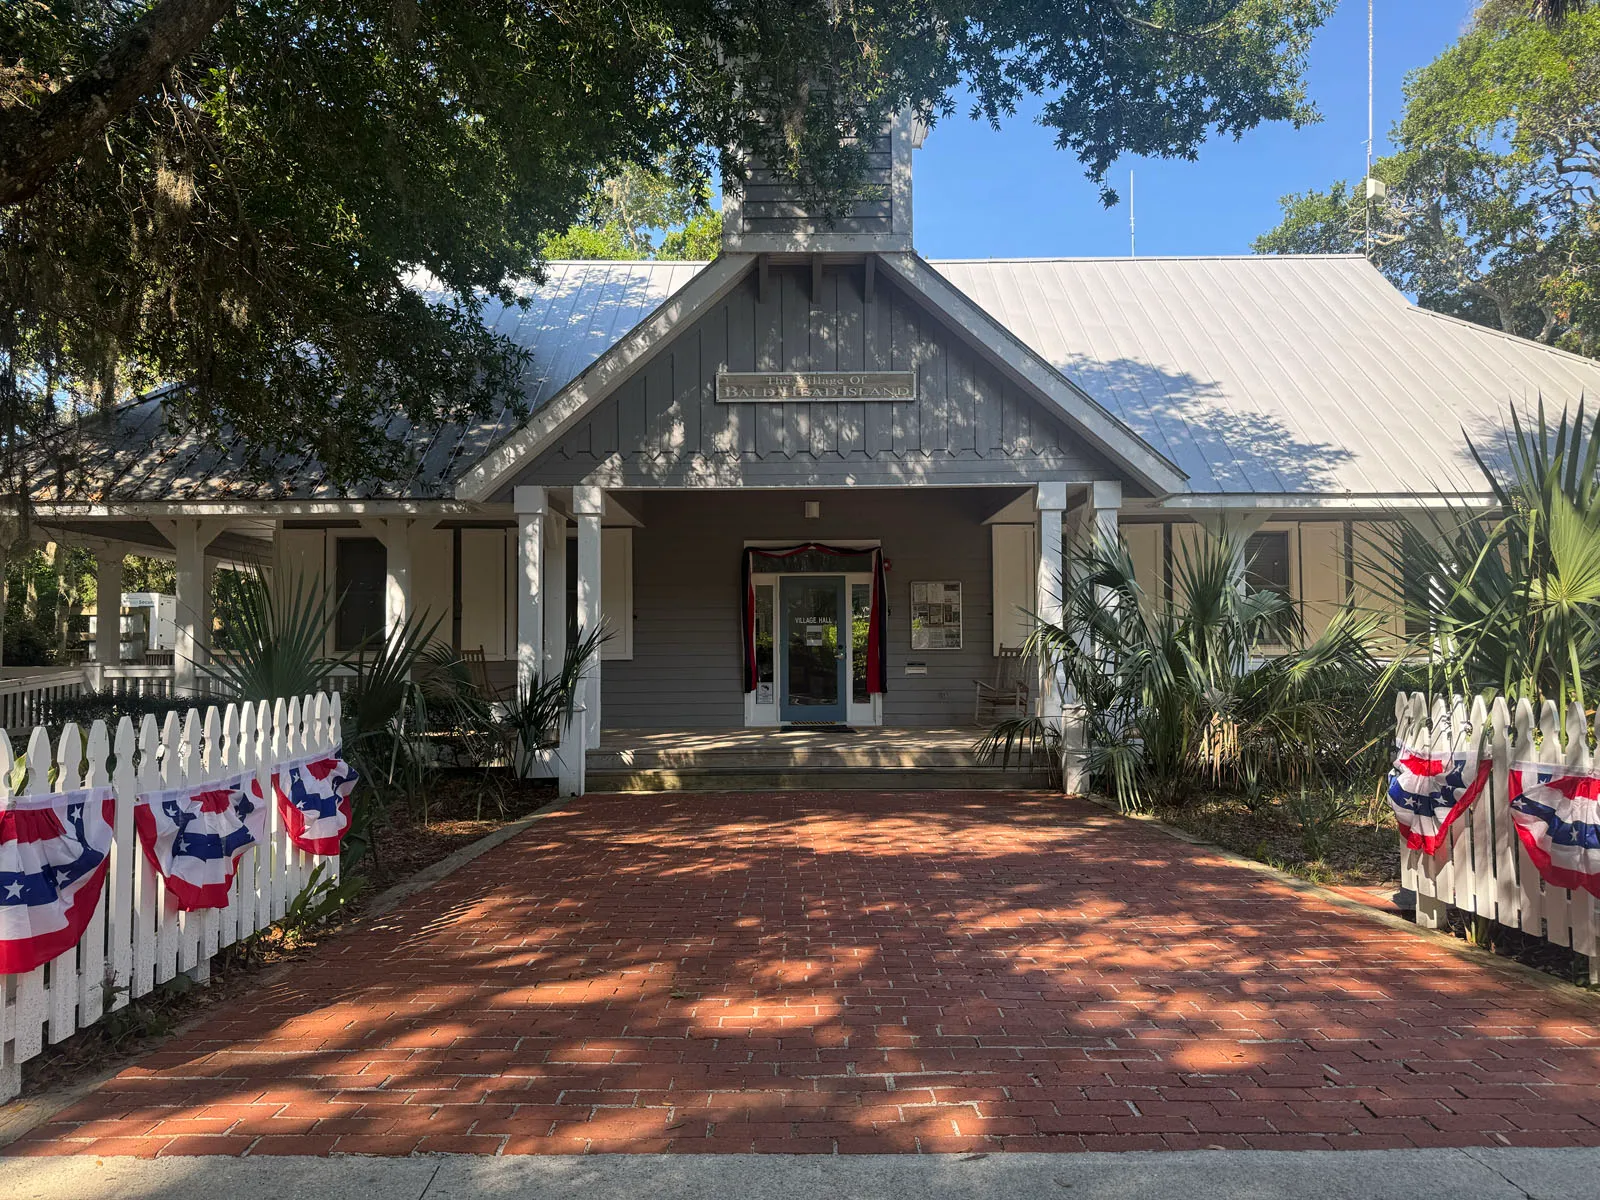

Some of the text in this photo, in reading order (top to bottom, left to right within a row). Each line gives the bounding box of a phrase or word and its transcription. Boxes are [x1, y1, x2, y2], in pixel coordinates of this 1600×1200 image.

[766, 375, 867, 387] The Village Of
[724, 385, 910, 397] BALD HEAD ISLAND
[794, 616, 832, 624] VILLAGE HALL
